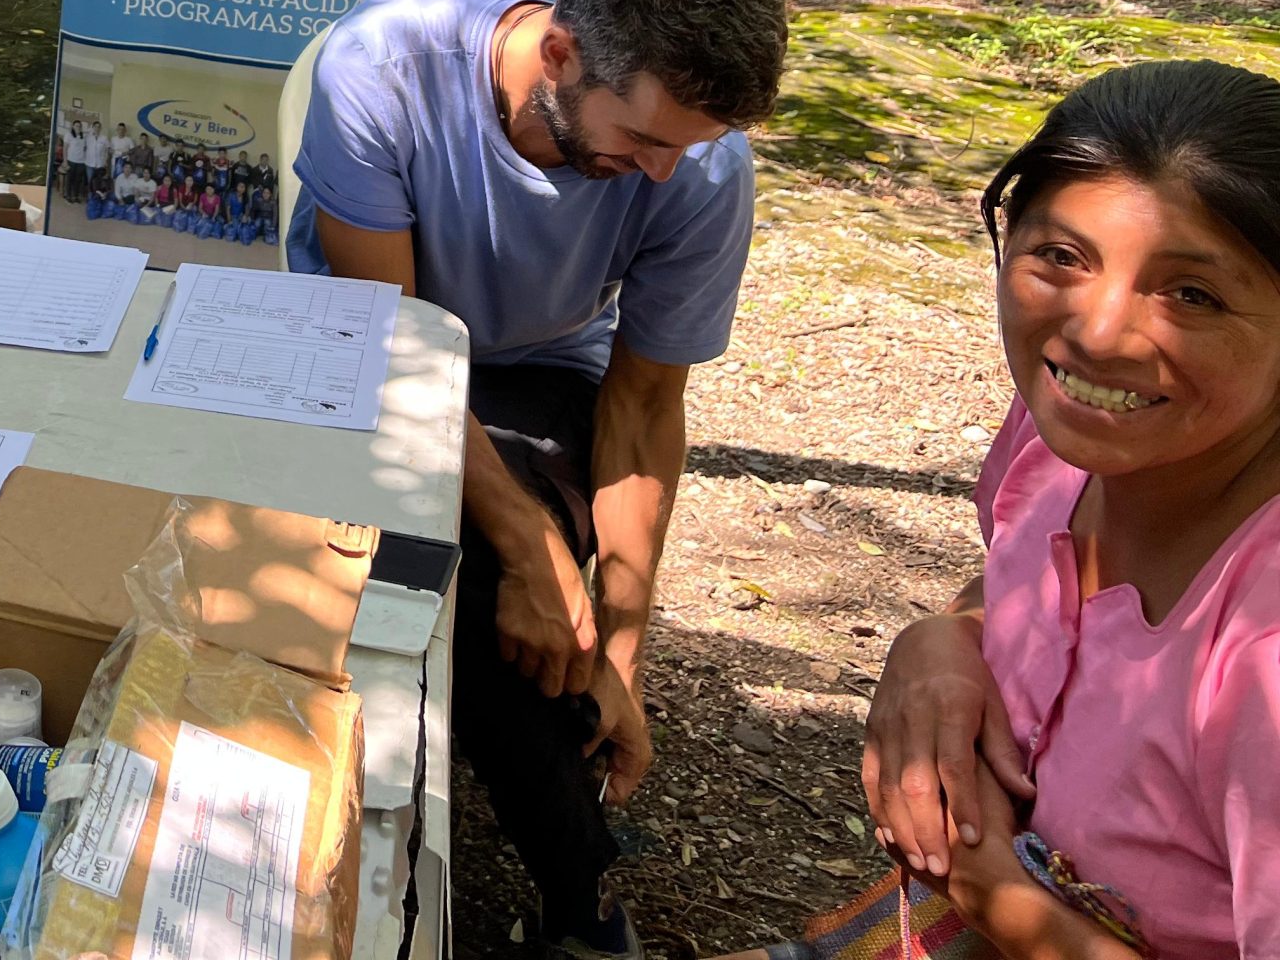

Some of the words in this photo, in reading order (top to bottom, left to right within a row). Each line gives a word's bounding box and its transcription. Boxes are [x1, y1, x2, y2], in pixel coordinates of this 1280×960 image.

[299, 15, 334, 36] SO
[163, 114, 188, 128] Paz
[207, 123, 238, 136] Bien
